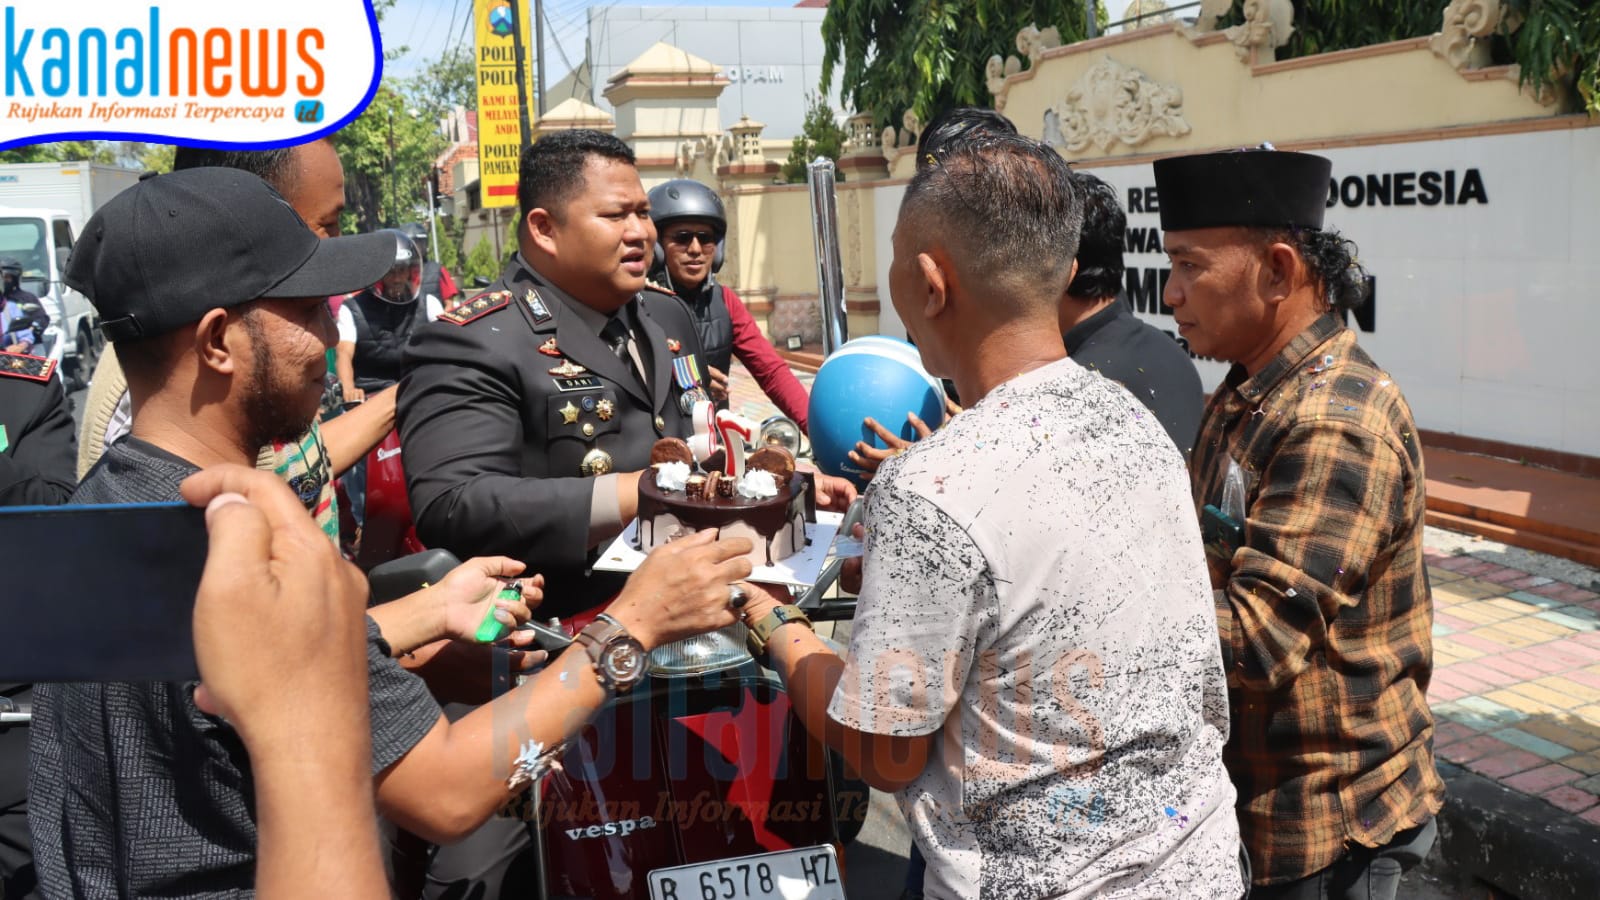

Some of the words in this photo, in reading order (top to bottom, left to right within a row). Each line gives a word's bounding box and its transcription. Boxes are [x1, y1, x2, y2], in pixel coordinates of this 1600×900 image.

[481, 46, 526, 61] POLII
[481, 70, 528, 85] POLI
[483, 95, 505, 106] KAMI
[485, 110, 519, 121] MELAYA
[495, 123, 518, 134] ANDA
[484, 144, 521, 158] POLR
[484, 160, 520, 175] PAMEKA
[565, 815, 657, 841] vespa
[700, 862, 774, 900] 6578
[801, 854, 836, 887] HZ
